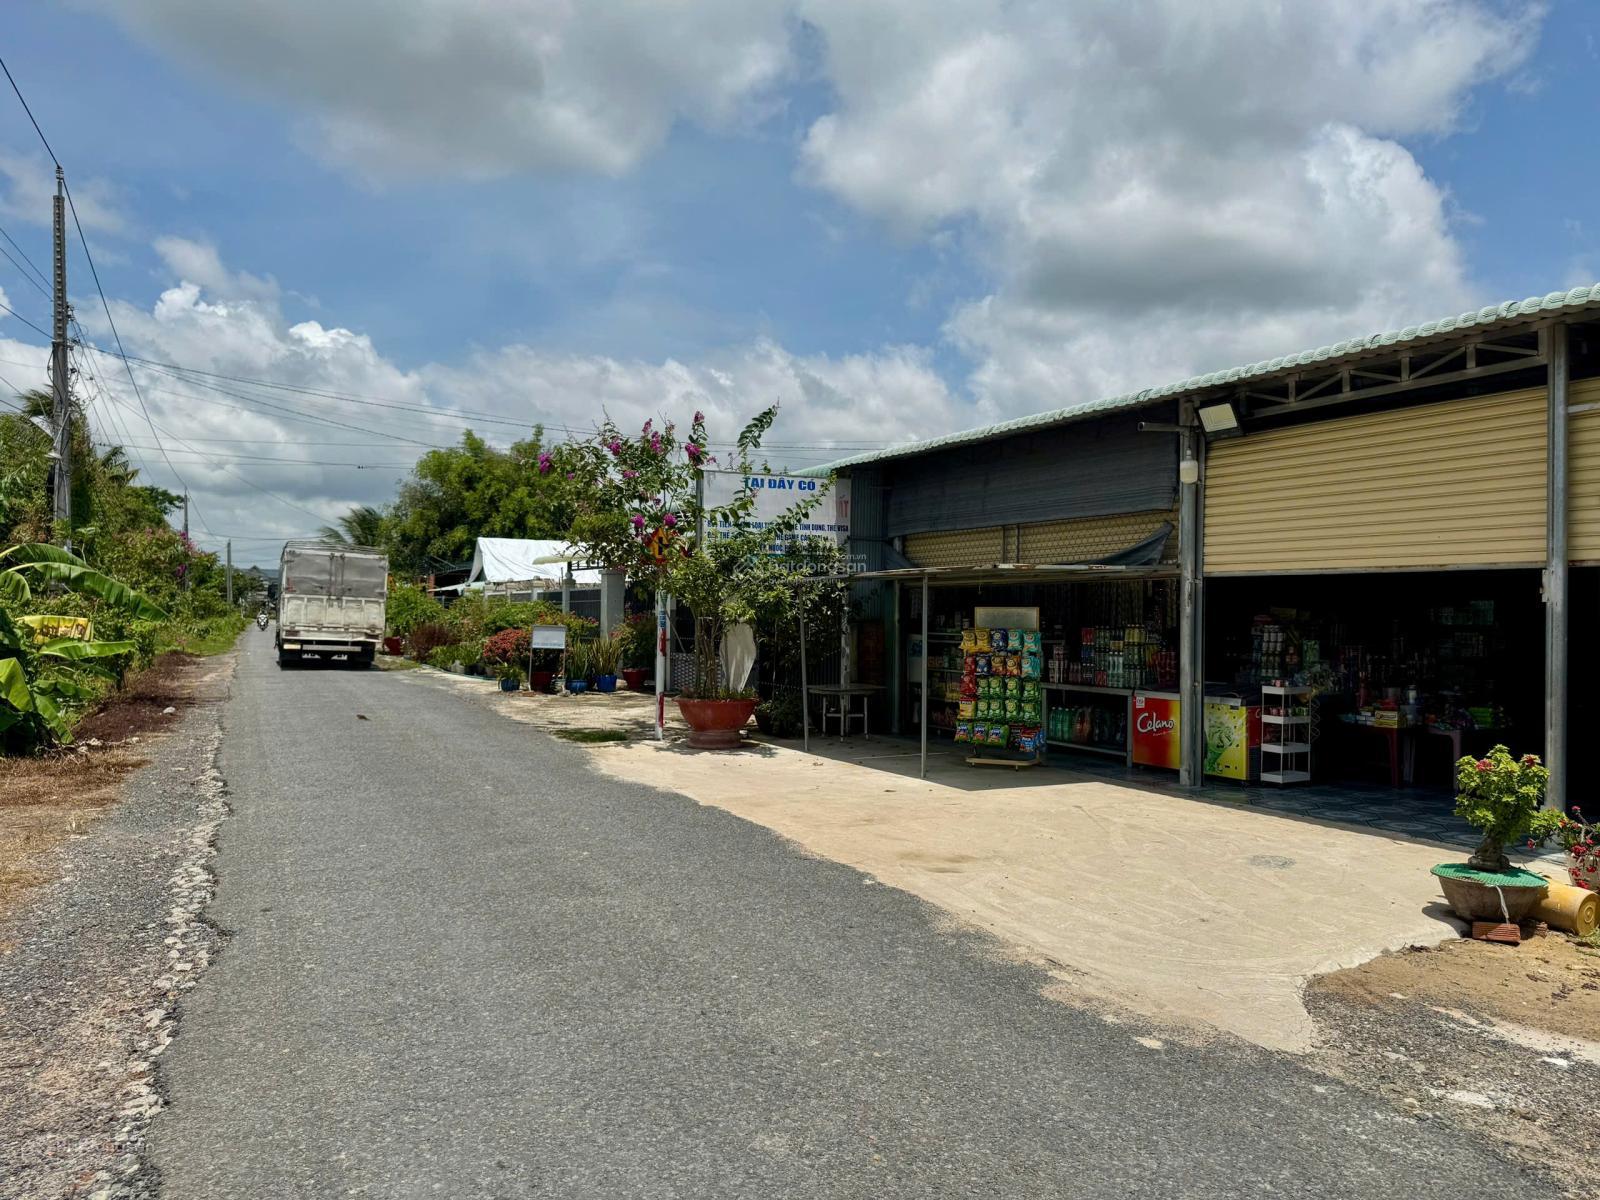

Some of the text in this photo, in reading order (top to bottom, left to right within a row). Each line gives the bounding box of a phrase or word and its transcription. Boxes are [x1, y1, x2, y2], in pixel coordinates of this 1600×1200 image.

[768, 477, 795, 490] ĐÂY
[798, 478, 816, 491] CÓ
[1136, 711, 1176, 733] Celano
